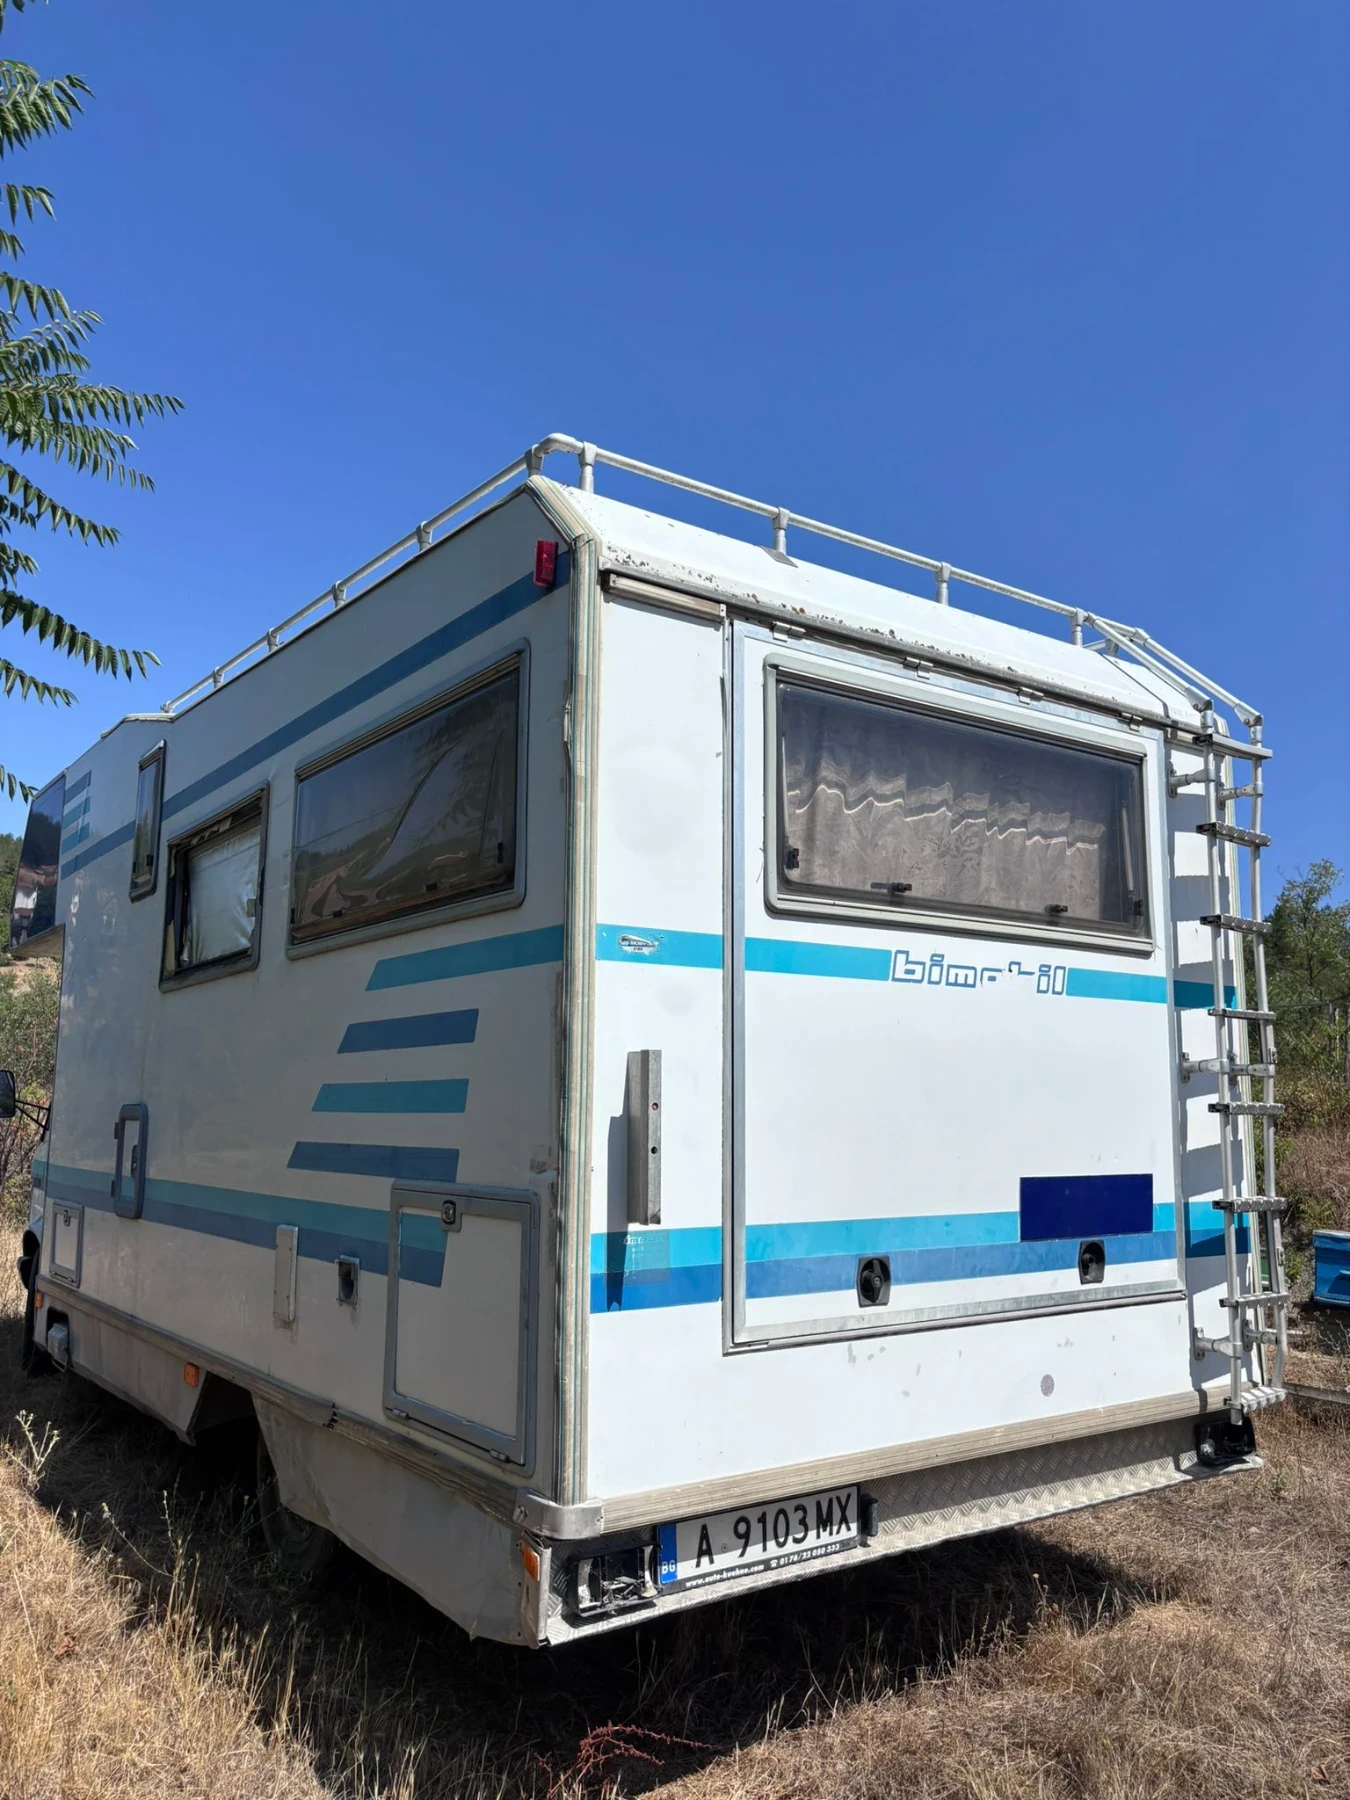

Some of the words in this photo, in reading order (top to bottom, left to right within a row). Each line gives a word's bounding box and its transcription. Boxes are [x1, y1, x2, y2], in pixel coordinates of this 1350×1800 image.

[695, 1524, 715, 1568] A
[733, 1504, 808, 1558] 9103
[816, 1494, 851, 1539] MX
[661, 1560, 676, 1574] BG
[685, 1564, 765, 1588] www.auto-kuehne.com
